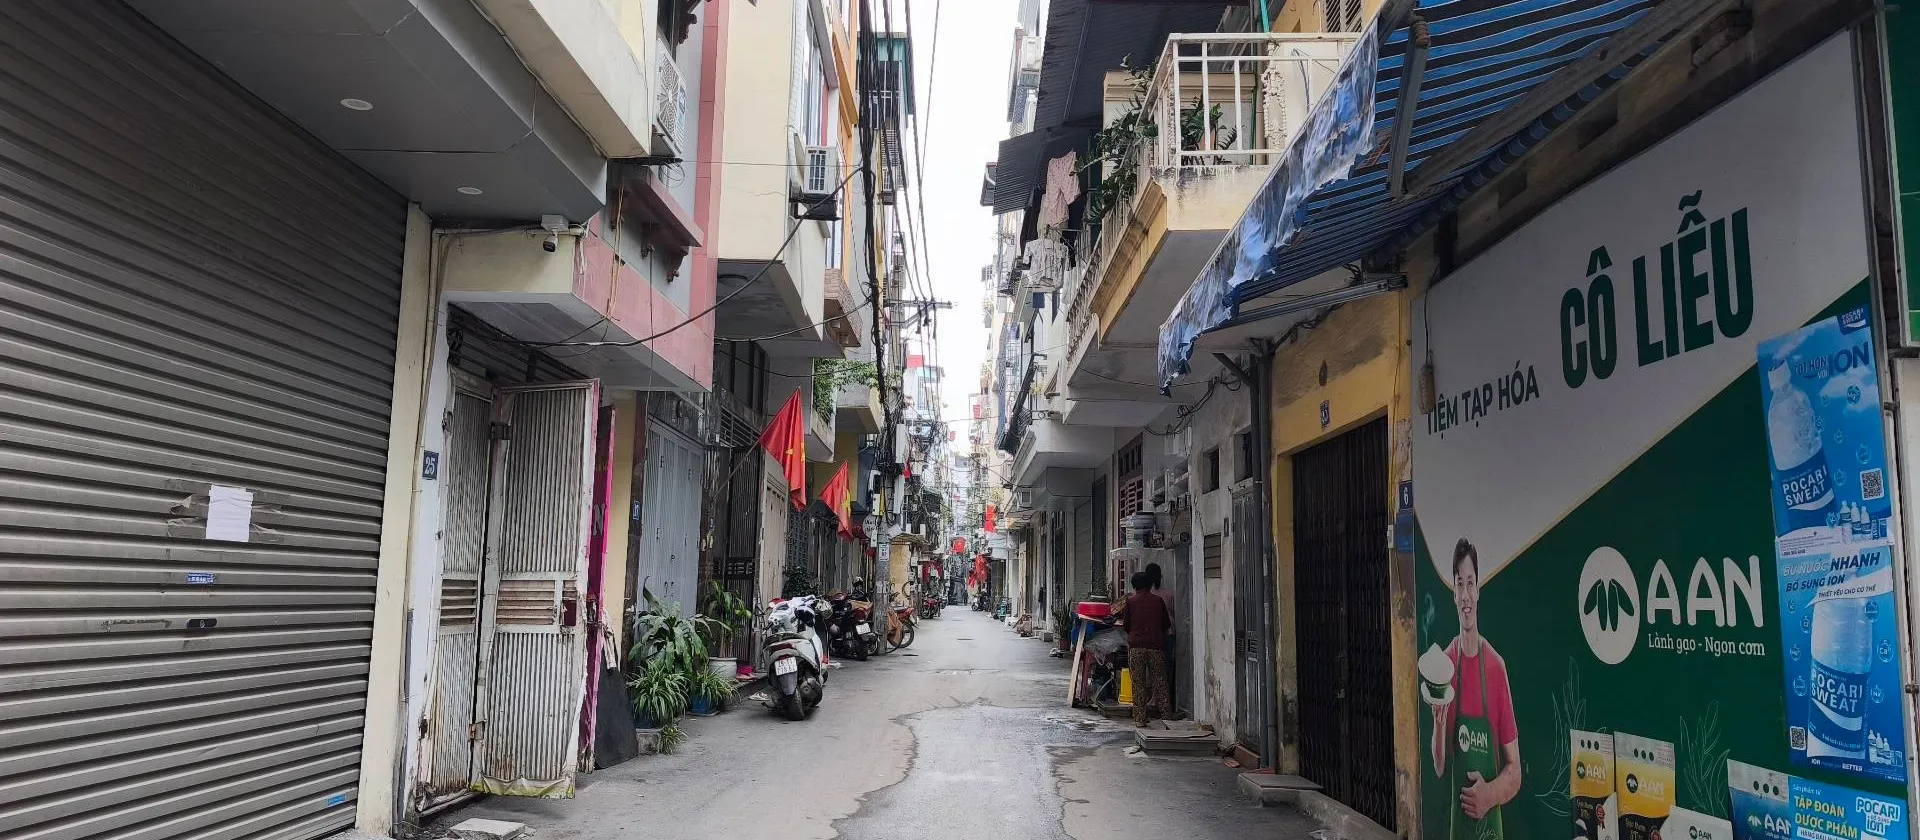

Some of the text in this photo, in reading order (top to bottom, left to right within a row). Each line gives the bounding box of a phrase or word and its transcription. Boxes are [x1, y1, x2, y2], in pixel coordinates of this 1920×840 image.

[1560, 189, 1754, 389] CÔ LIỄU
[1828, 341, 1869, 376] ION
[1462, 382, 1493, 428] TẠP
[1498, 360, 1540, 411] HÓA
[425, 456, 436, 475] 25
[1782, 465, 1827, 494] POCARI
[1786, 479, 1825, 506] SWEAT
[1404, 486, 1410, 506] 6
[1830, 551, 1881, 572] NHANH
[1800, 577, 1825, 591] SUNG
[1827, 574, 1845, 586] ION
[1648, 632, 1674, 650] Lành
[1676, 636, 1696, 654] gạo
[1705, 636, 1736, 657] Ngon
[1811, 667, 1863, 699] POCARI
[1811, 682, 1858, 713] SWEAT
[1857, 798, 1899, 819] POCARI
